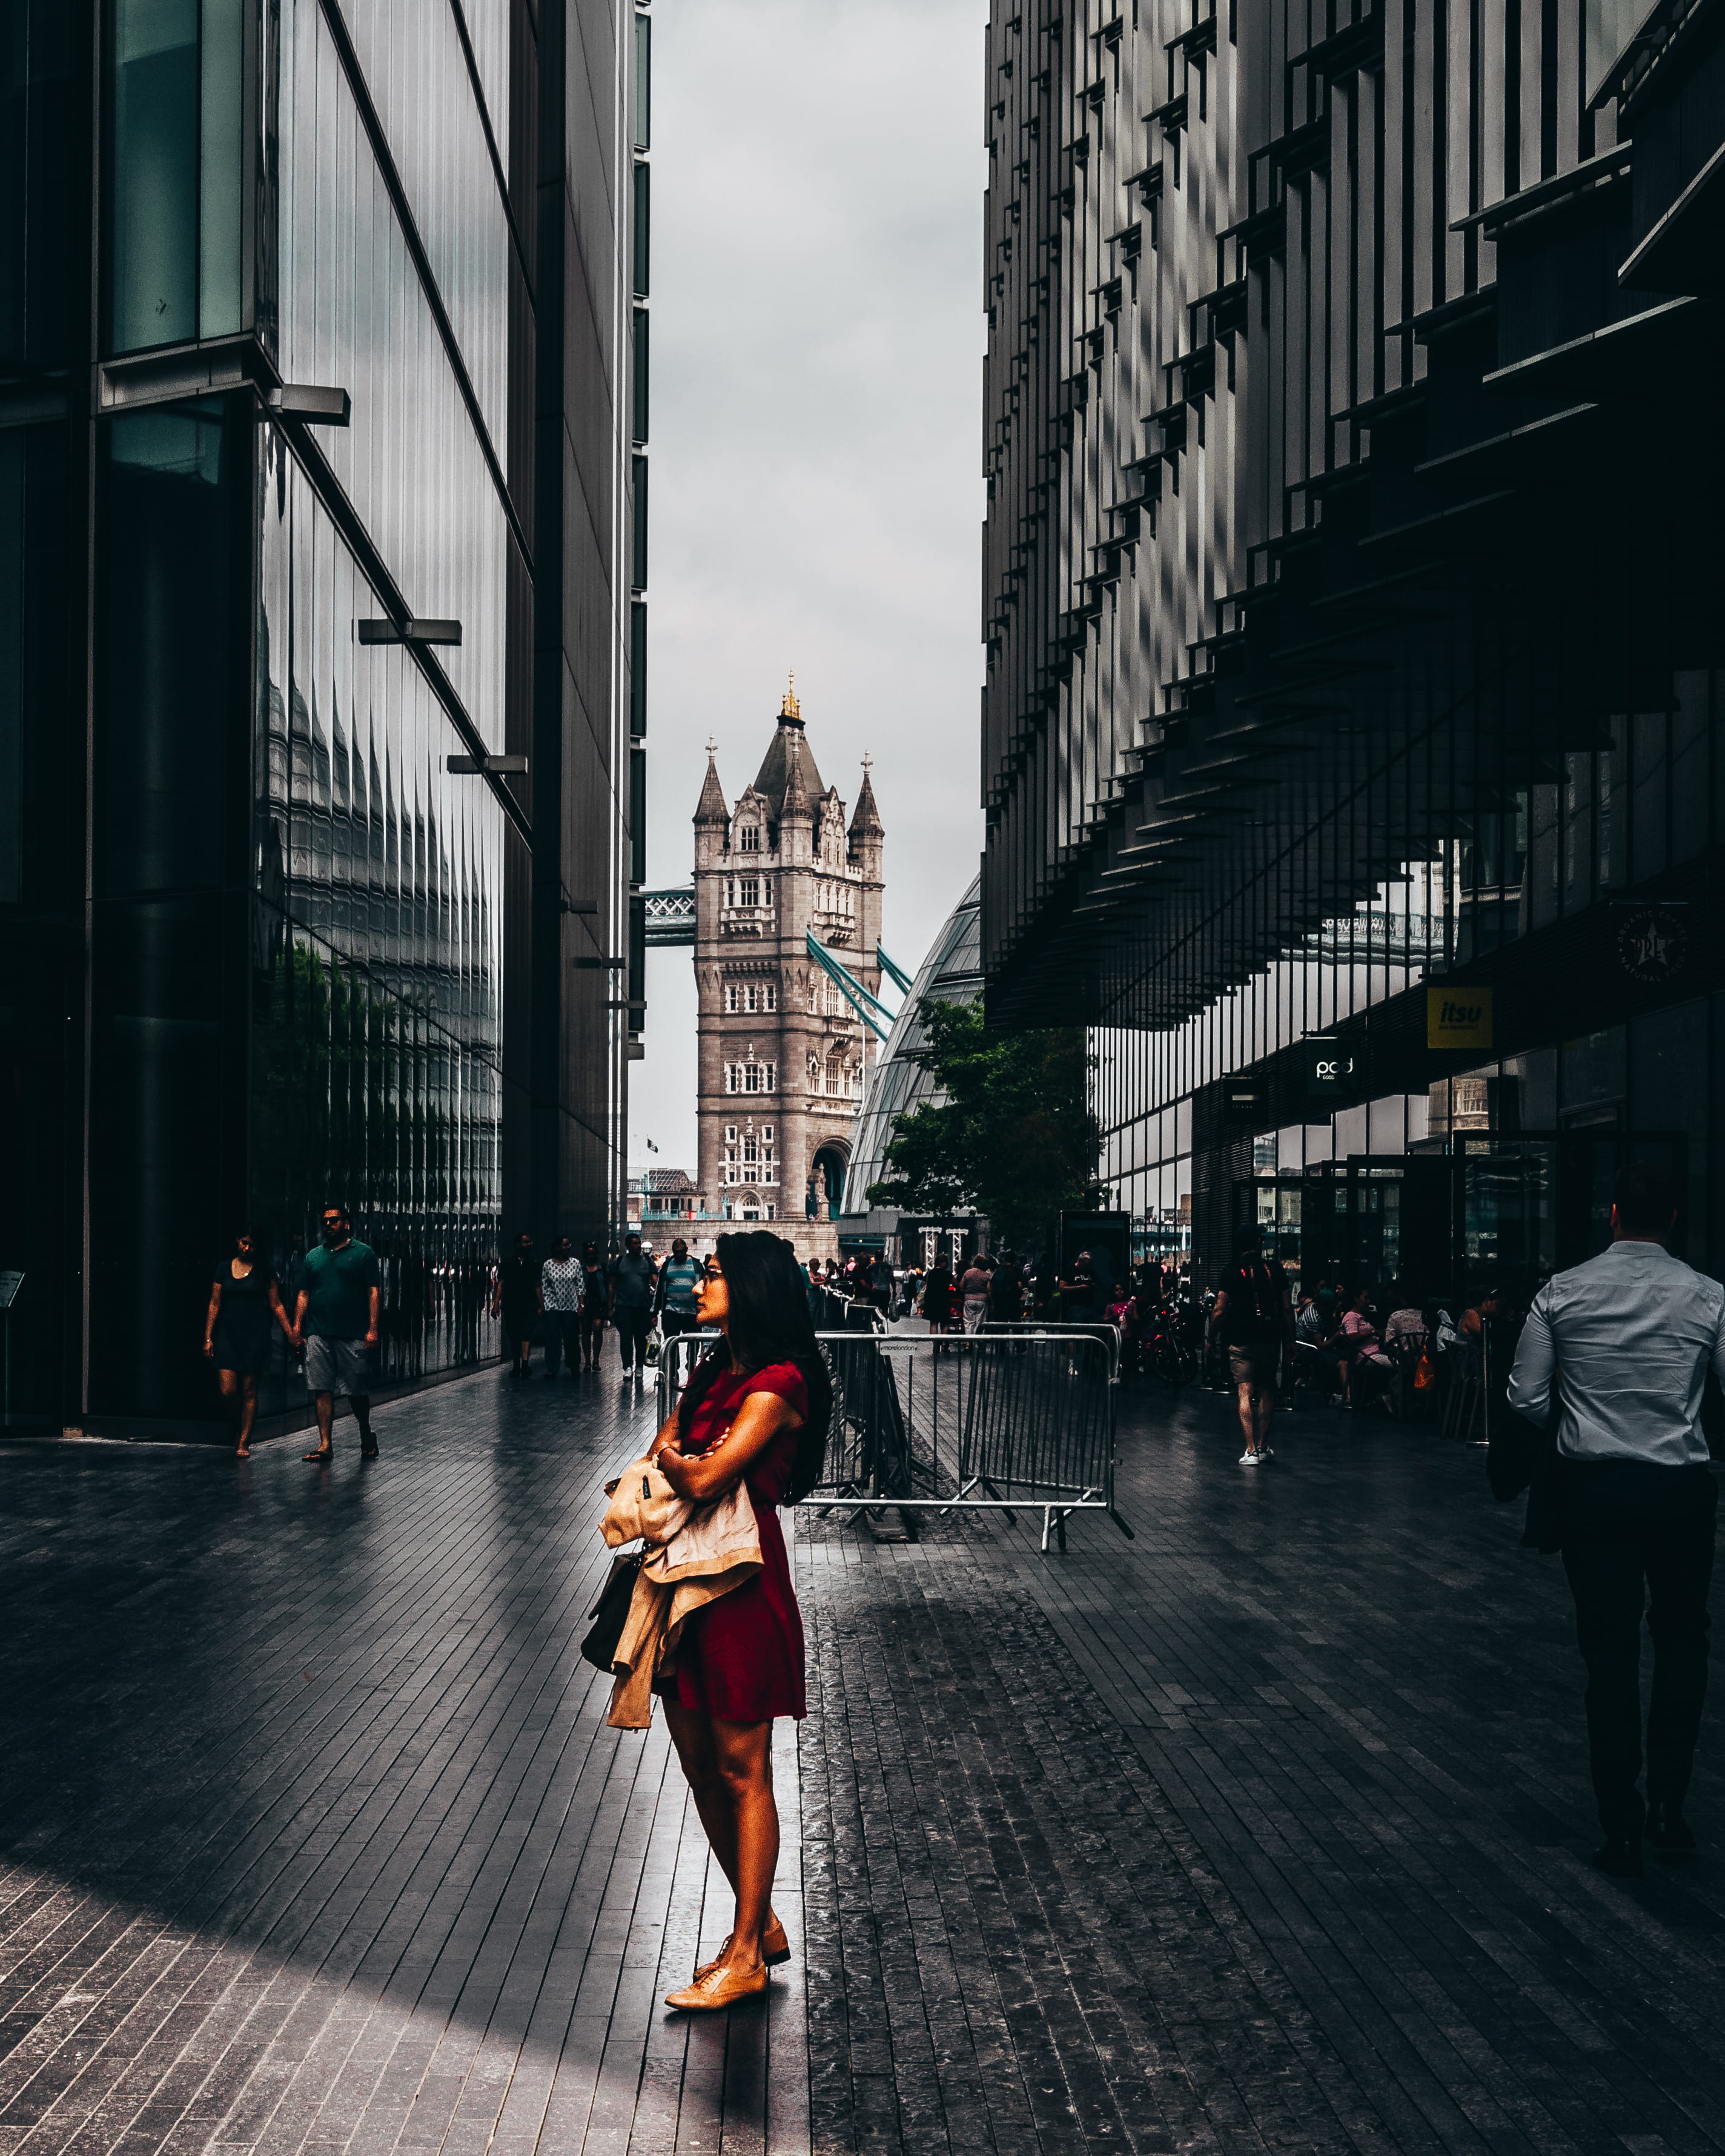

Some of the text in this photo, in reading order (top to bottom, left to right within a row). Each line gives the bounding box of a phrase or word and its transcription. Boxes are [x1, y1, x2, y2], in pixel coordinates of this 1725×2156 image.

[1618, 910, 1653, 943] ORGANIC
[1634, 934, 1672, 960] PRET
[1621, 955, 1686, 982] NATURAL FOOD
[1440, 1002, 1482, 1022] itsu
[1316, 1057, 1353, 1078] pod
